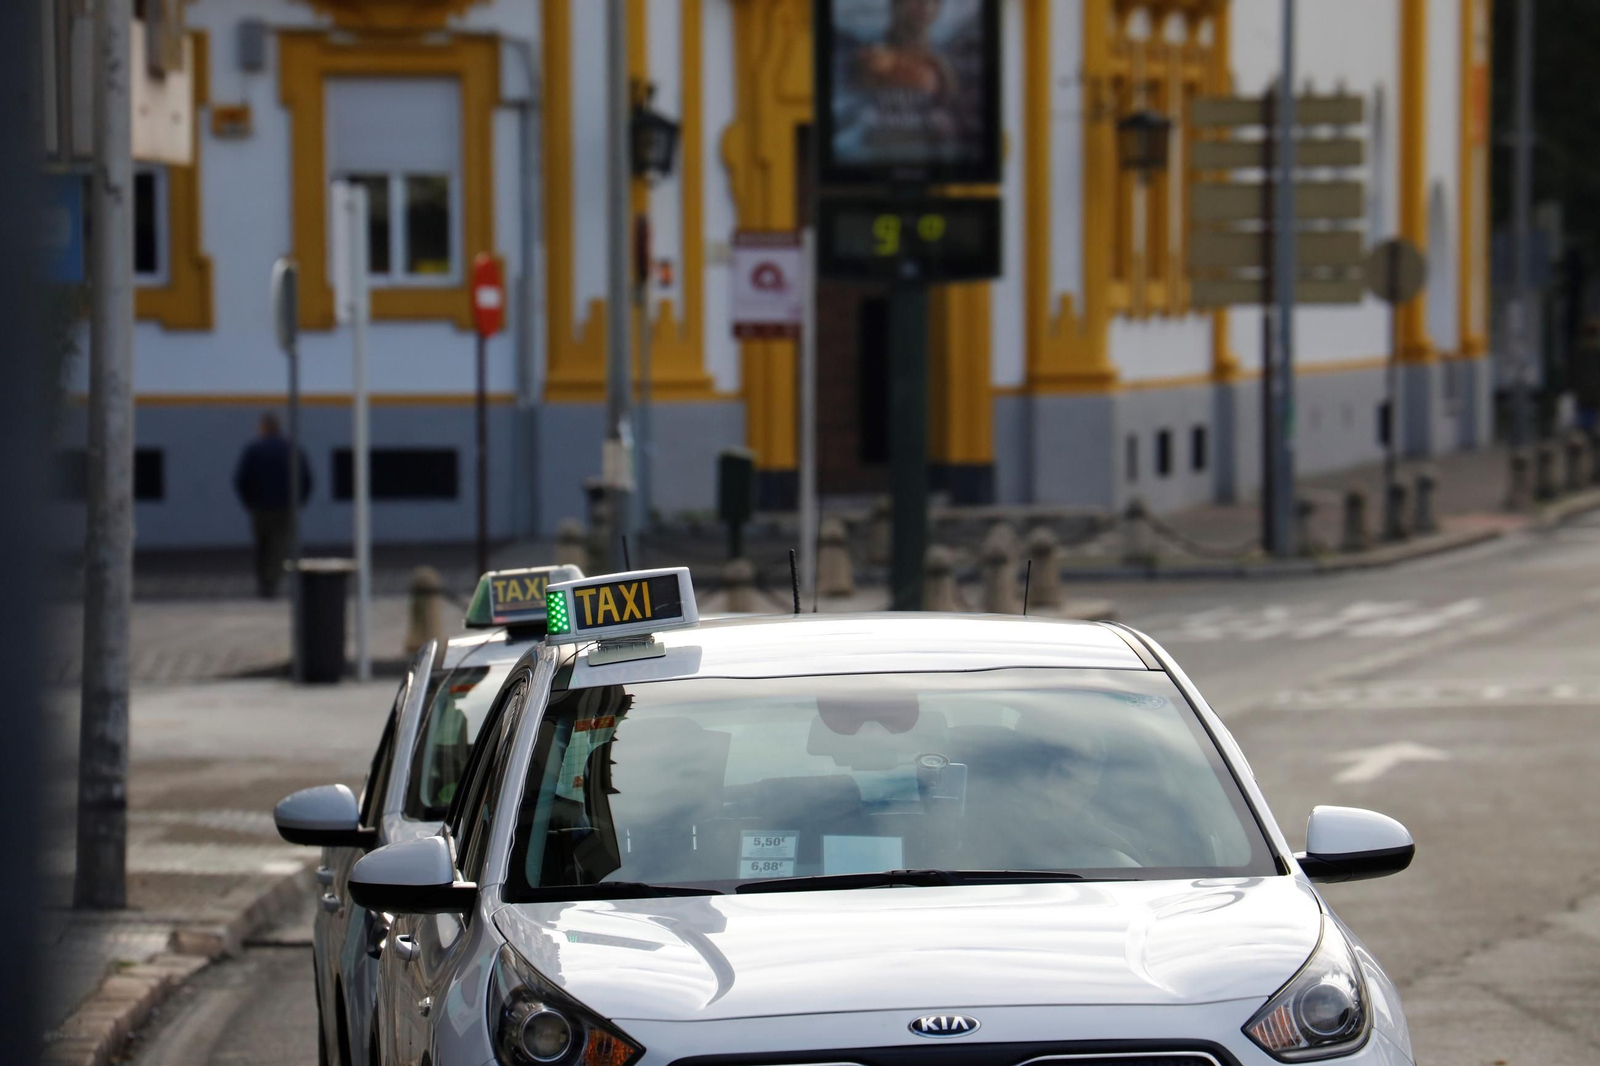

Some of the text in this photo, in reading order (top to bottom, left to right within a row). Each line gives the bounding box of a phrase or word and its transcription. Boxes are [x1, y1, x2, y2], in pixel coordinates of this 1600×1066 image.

[575, 581, 652, 626] TAXI
[753, 837, 786, 848] 5,50€
[920, 1016, 969, 1031] KIA
